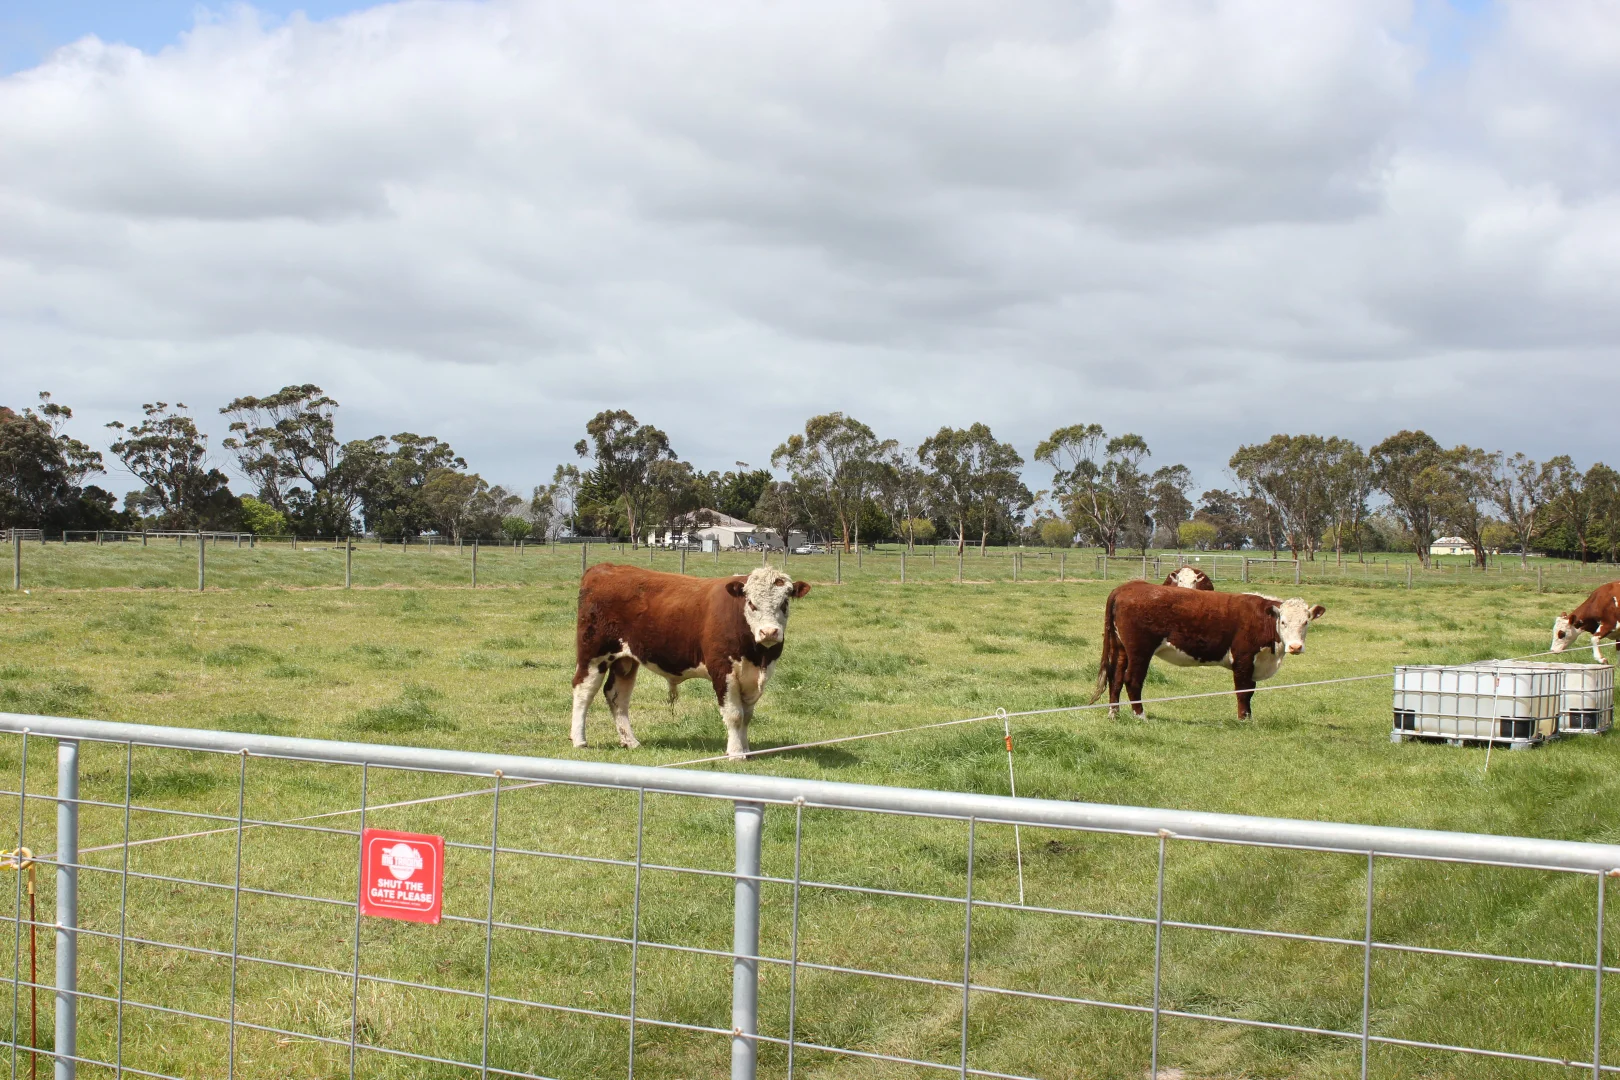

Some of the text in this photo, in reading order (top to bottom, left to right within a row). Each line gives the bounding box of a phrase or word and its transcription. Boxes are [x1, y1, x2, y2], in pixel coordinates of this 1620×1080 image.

[378, 878, 423, 892] SHUT THE
[371, 888, 395, 899] GATE
[397, 891, 432, 903] PLEASE
